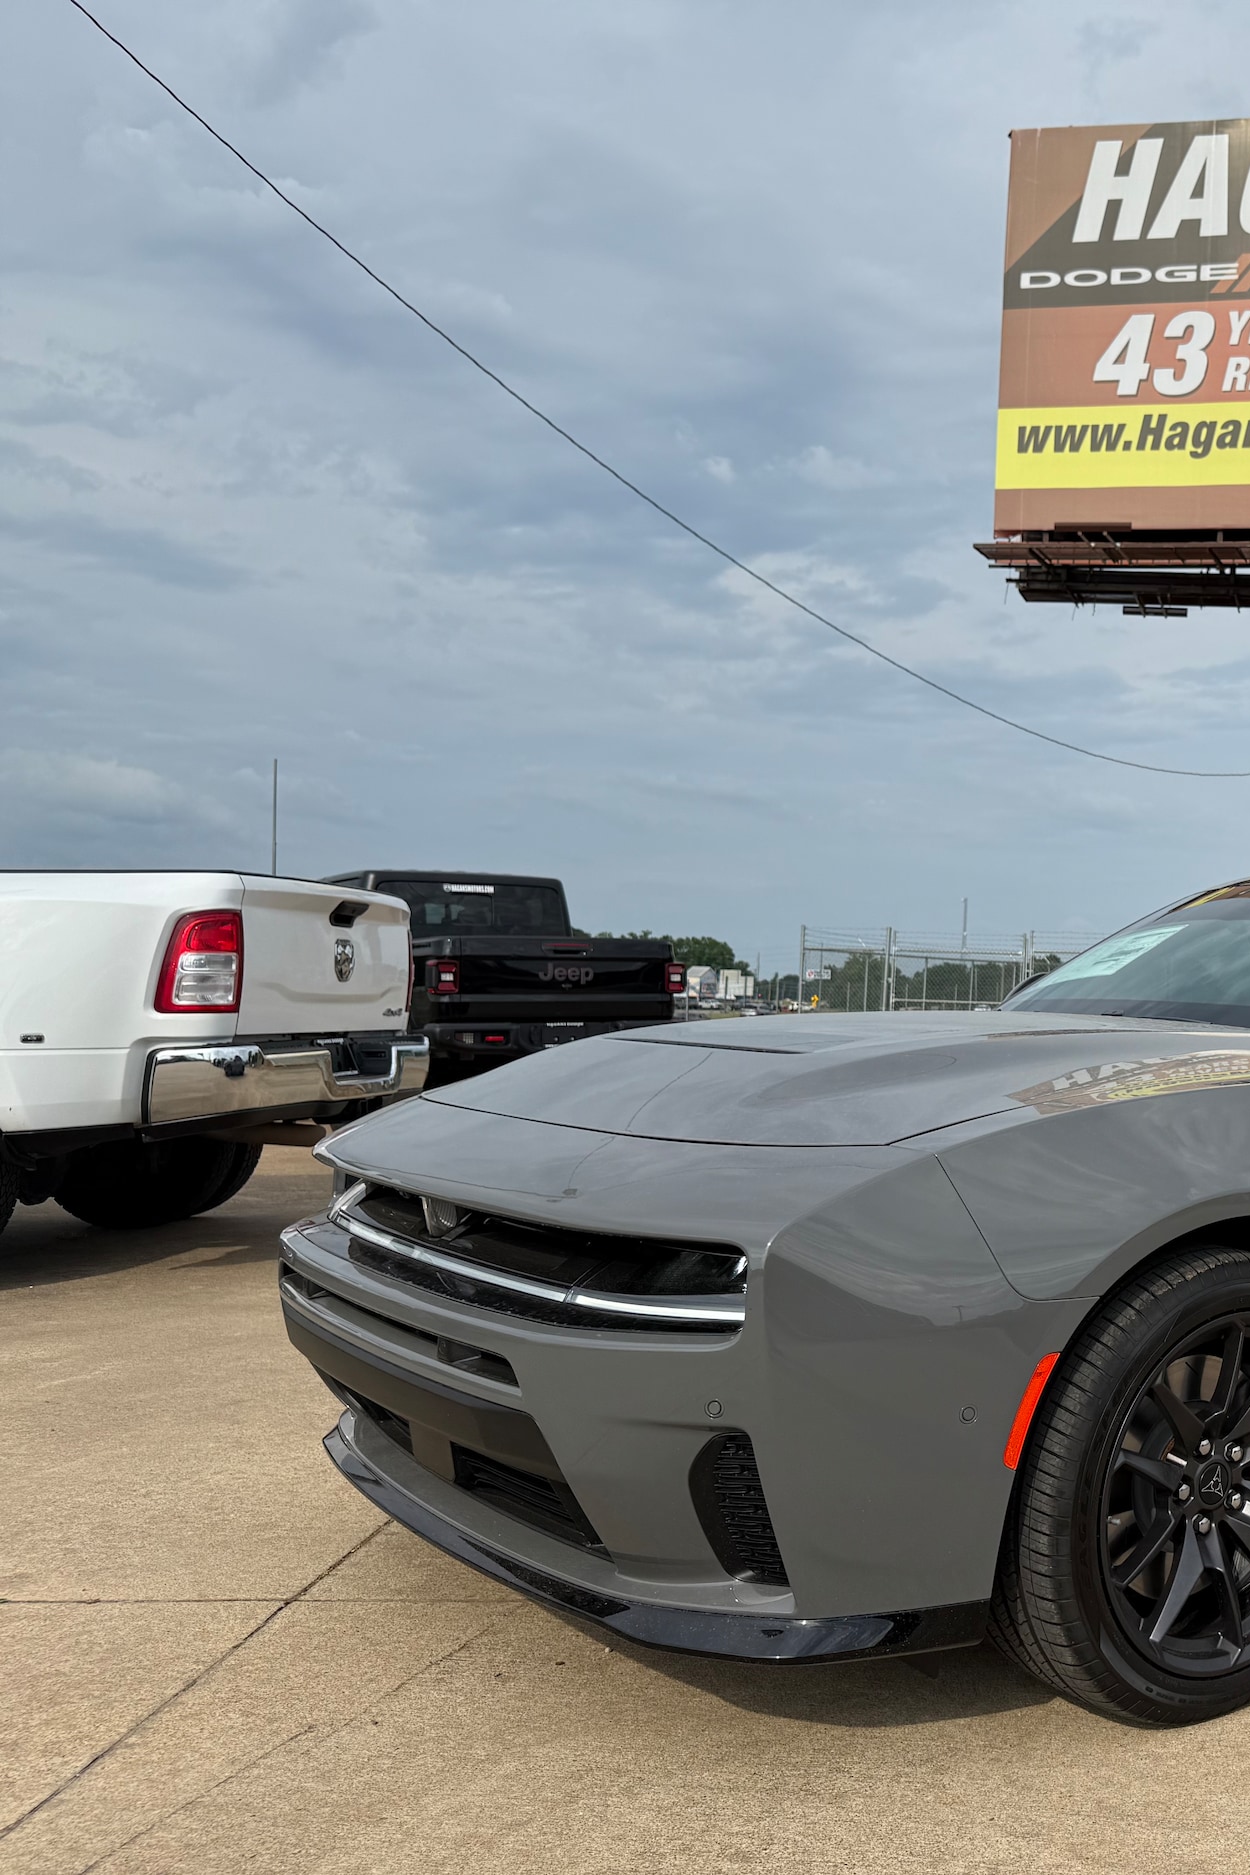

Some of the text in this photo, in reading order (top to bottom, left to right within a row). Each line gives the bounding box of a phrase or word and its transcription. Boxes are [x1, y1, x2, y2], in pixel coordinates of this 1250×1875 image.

[1019, 263, 1239, 289] DODGE
[1092, 310, 1216, 397] 43
[538, 962, 594, 985] Jeep
